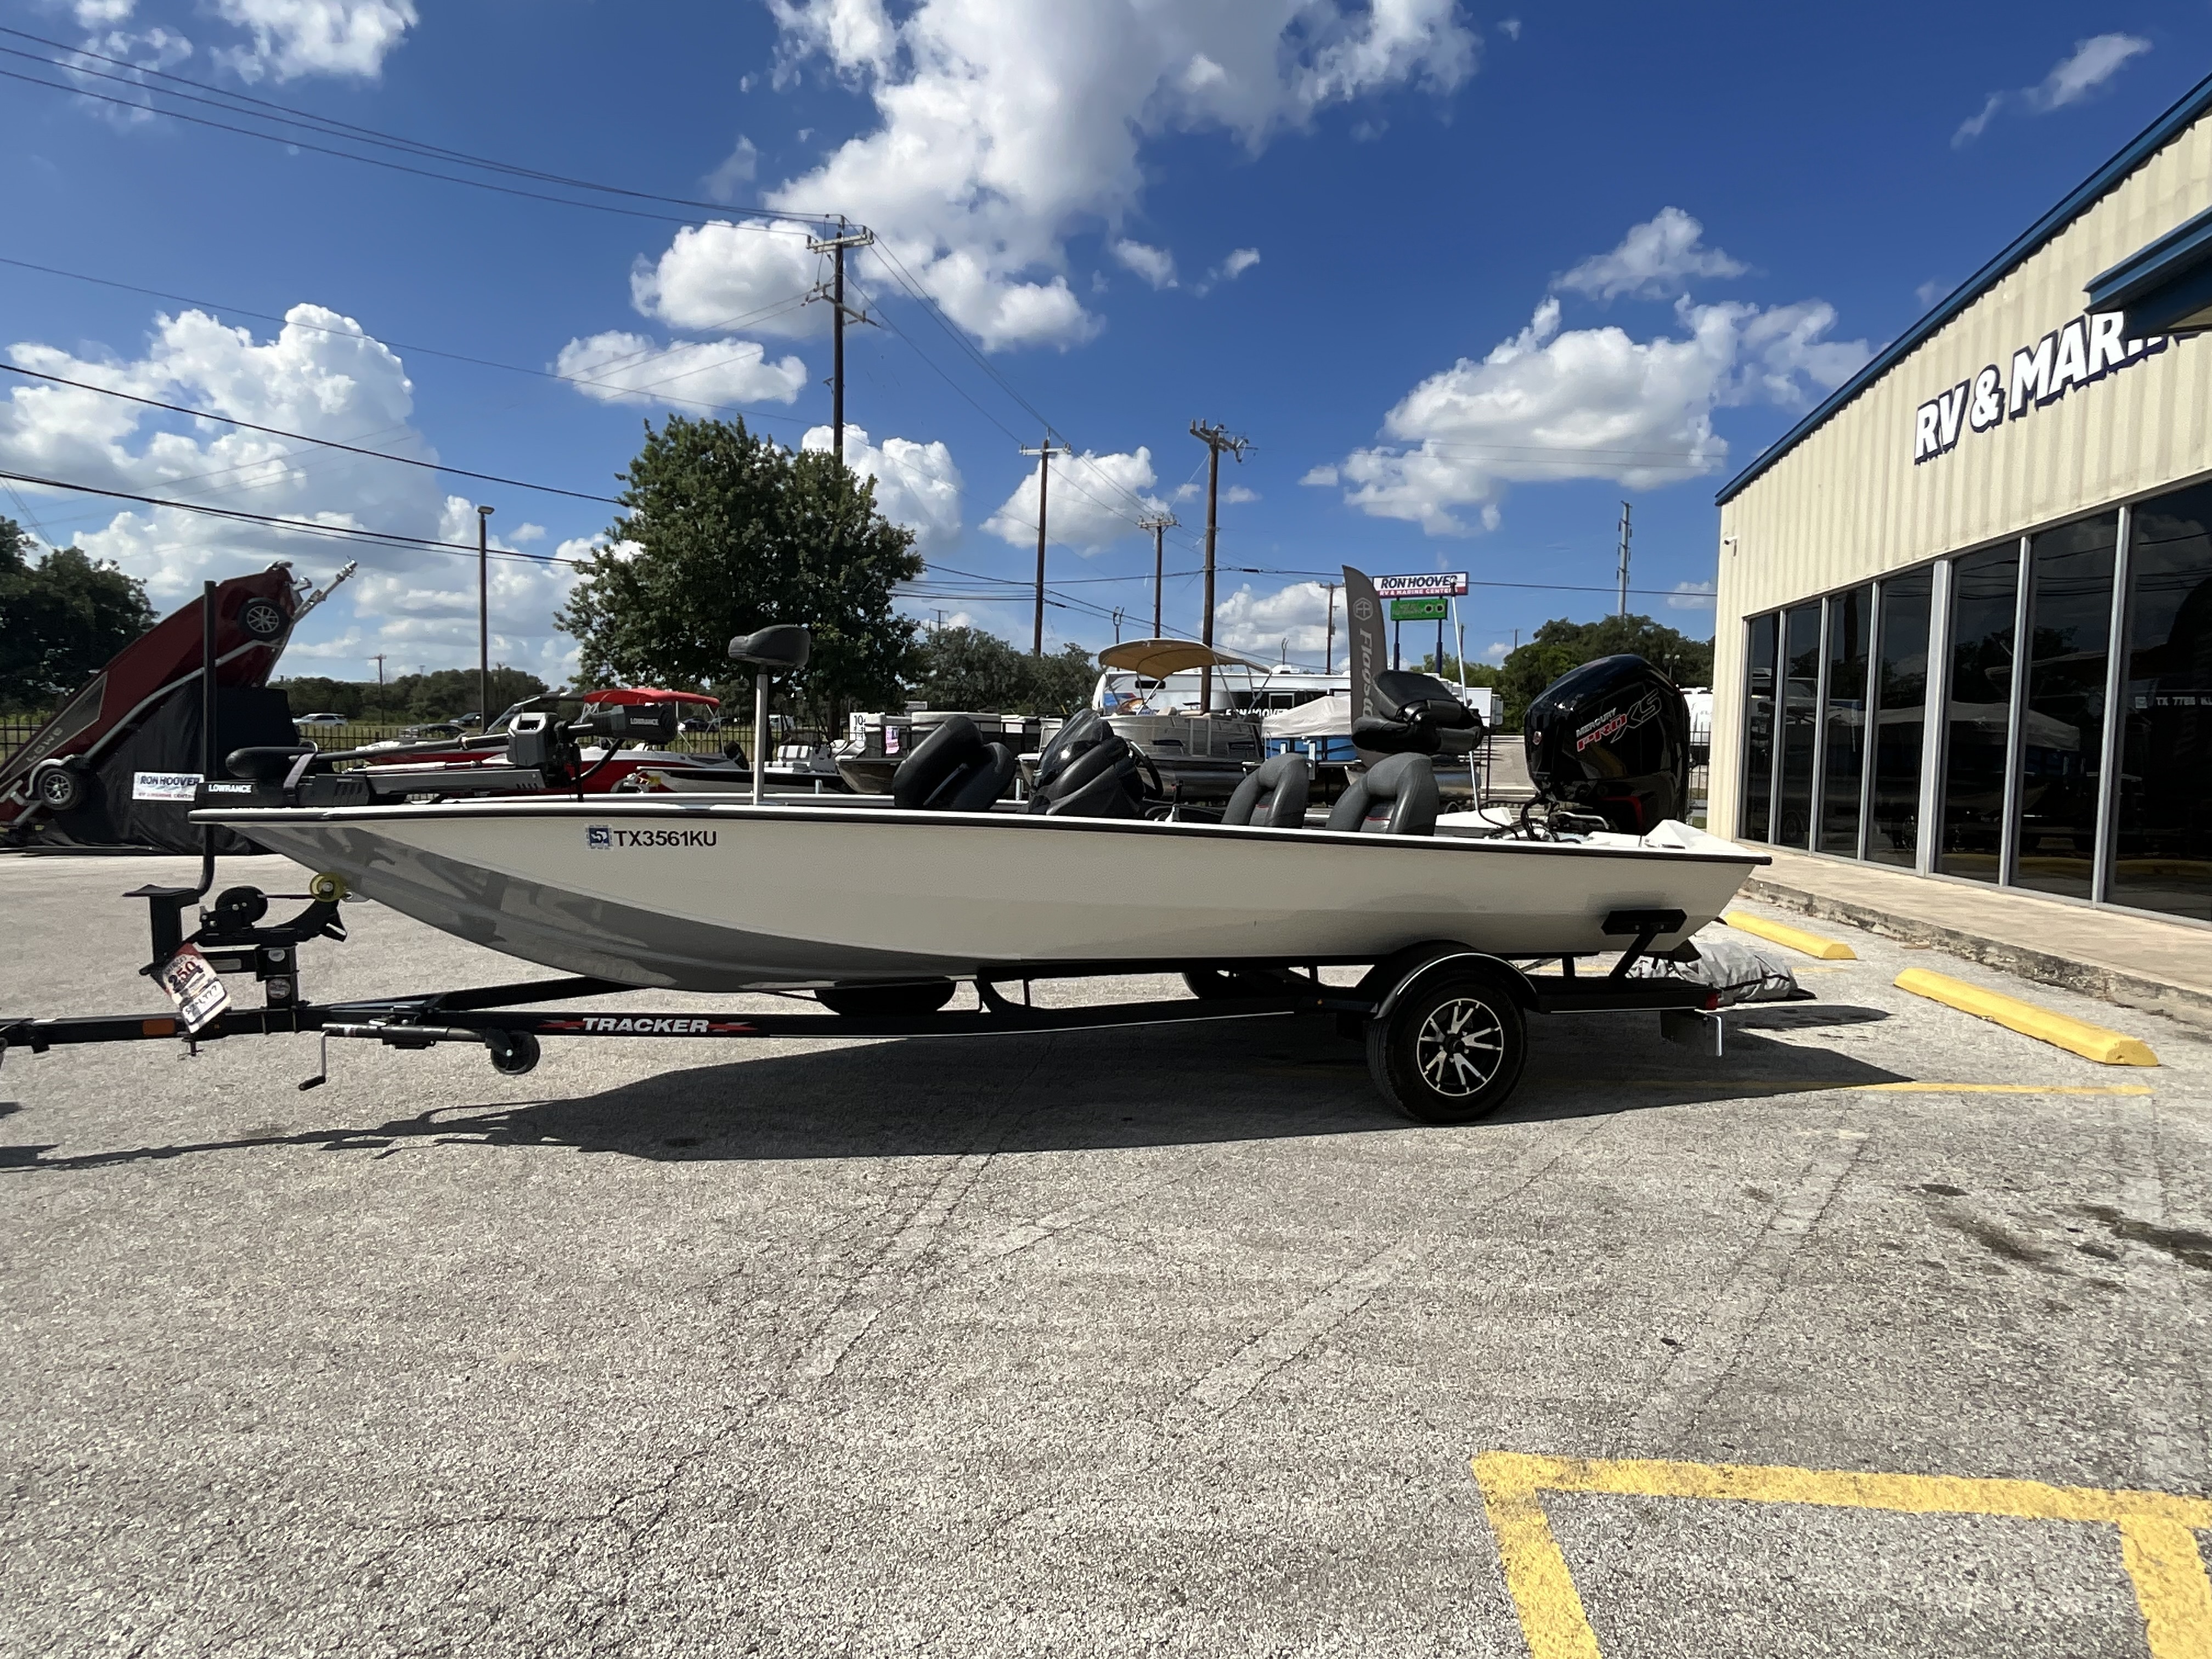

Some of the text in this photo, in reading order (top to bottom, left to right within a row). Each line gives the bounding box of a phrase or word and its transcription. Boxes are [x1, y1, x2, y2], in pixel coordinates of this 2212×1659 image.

[1914, 311, 2168, 465] RV & MAR
[1381, 577, 1406, 589] RON
[1576, 707, 1616, 737] MERCURY
[140, 776, 200, 786] RON HOOVER
[208, 784, 252, 793] LOWRANCE
[613, 831, 716, 847] TX3561KU
[168, 961, 197, 990] 250
[583, 1018, 709, 1032] TRACKER
